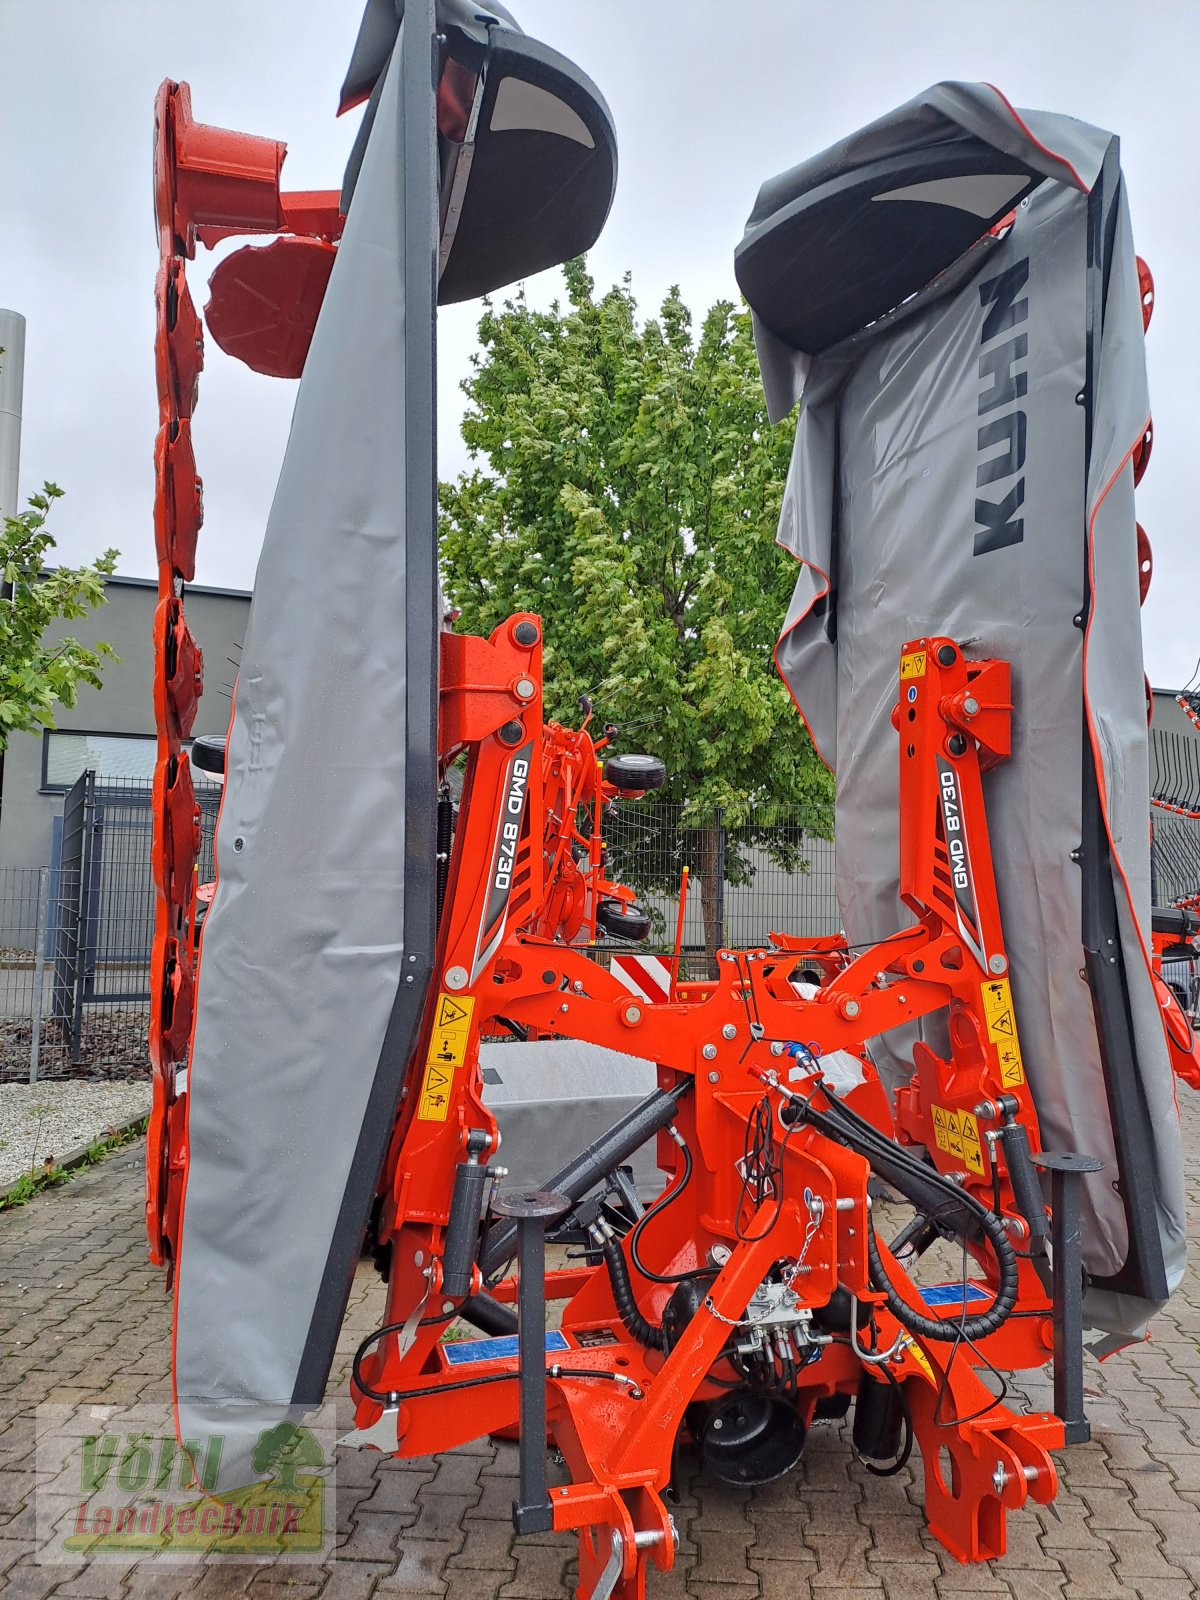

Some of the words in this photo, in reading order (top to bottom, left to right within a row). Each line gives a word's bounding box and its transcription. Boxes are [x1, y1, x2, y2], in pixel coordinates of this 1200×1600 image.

[973, 256, 1030, 557] KUHN
[508, 759, 529, 814] GMD
[940, 771, 961, 831] 8730
[495, 822, 519, 890] 8730
[950, 839, 968, 889] GMD
